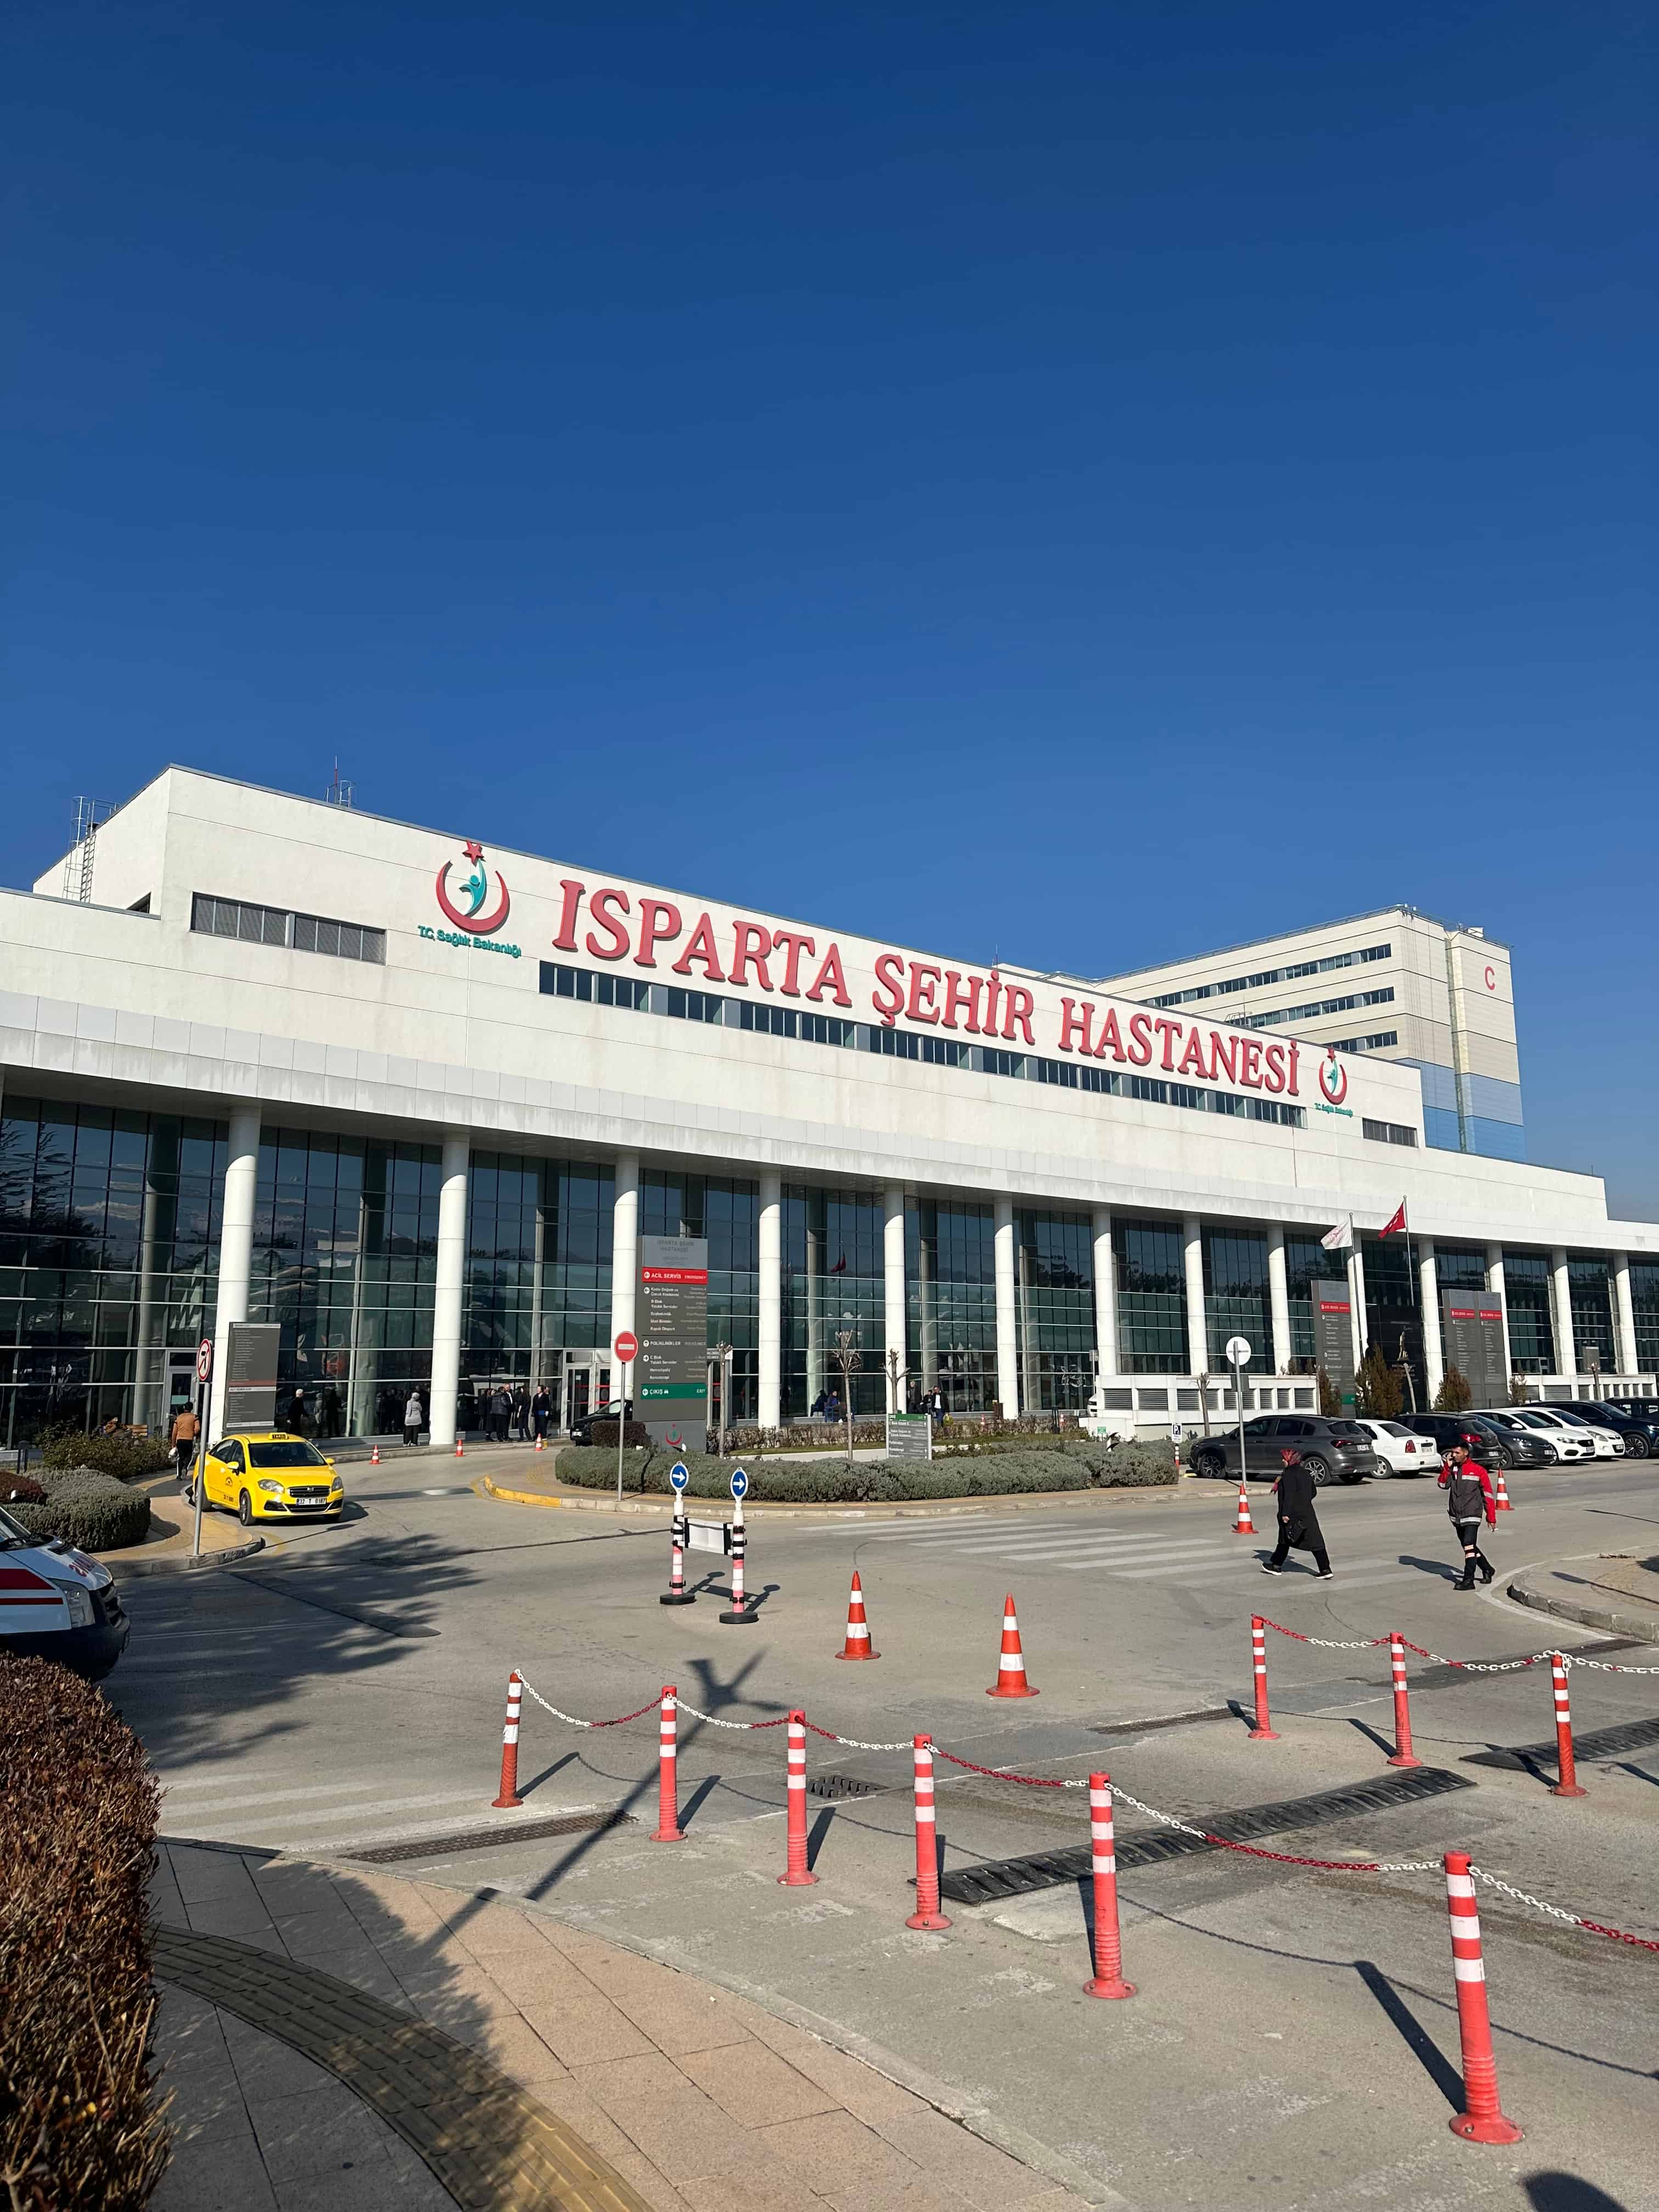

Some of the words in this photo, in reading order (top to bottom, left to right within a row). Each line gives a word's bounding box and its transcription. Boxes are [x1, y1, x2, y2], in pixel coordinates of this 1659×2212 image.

[437, 929, 471, 947] Sağlık
[473, 937, 522, 958] Bakanlığı
[552, 879, 853, 1006] ISPARTA
[872, 953, 1035, 1045] ŞEHİR
[1058, 997, 1300, 1096] HASTANESİ
[1485, 966, 1496, 991] C
